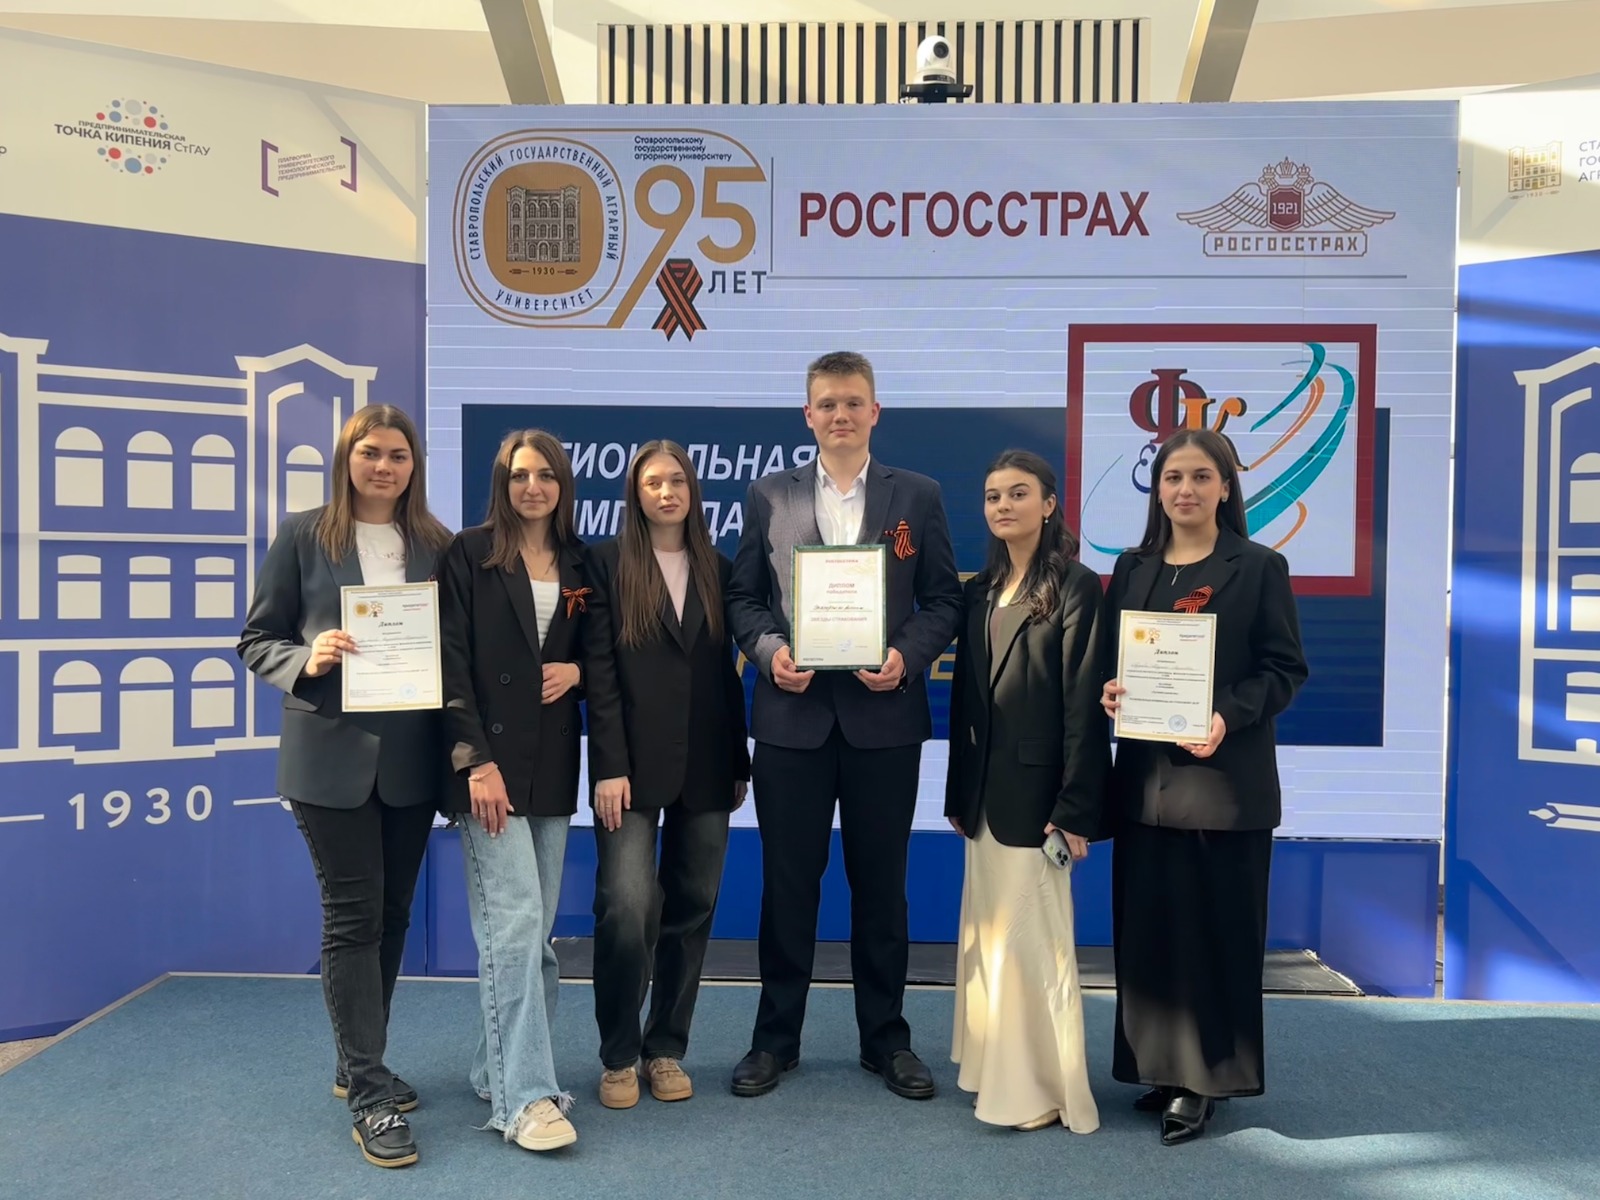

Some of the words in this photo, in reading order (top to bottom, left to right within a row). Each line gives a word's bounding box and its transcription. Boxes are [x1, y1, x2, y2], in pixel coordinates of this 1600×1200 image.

[54, 123, 103, 141] ТОЧКА
[105, 131, 171, 151] КИПЕНИЯ
[173, 142, 211, 156] СтГАУ
[78, 120, 186, 142] ПРЕДПРИНИМАТЕЛЬСКАЯ
[634, 136, 704, 146] Ставропольскому
[634, 144, 706, 153] государственному
[1579, 139, 1600, 152] СТ
[634, 153, 678, 161] аграрному
[679, 153, 732, 161] университету
[1579, 155, 1600, 167] ГО
[468, 153, 504, 260] СТАВРОПОЛЬСКИЙ
[510, 146, 614, 188] ГОСУДАРСТВЕННЫЙ
[606, 195, 619, 260] АГРАРНЫЙ
[1272, 203, 1299, 215] 1921
[800, 191, 1150, 237] РОСГОССТРАХ
[609, 165, 767, 326] 95
[1214, 237, 1358, 252] РОСГОССТРАХ
[532, 267, 555, 275] 1930
[708, 270, 767, 294] ЛЕТ
[495, 289, 594, 311] УНИВЕРСИТЕТ
[68, 784, 213, 830] 1930
